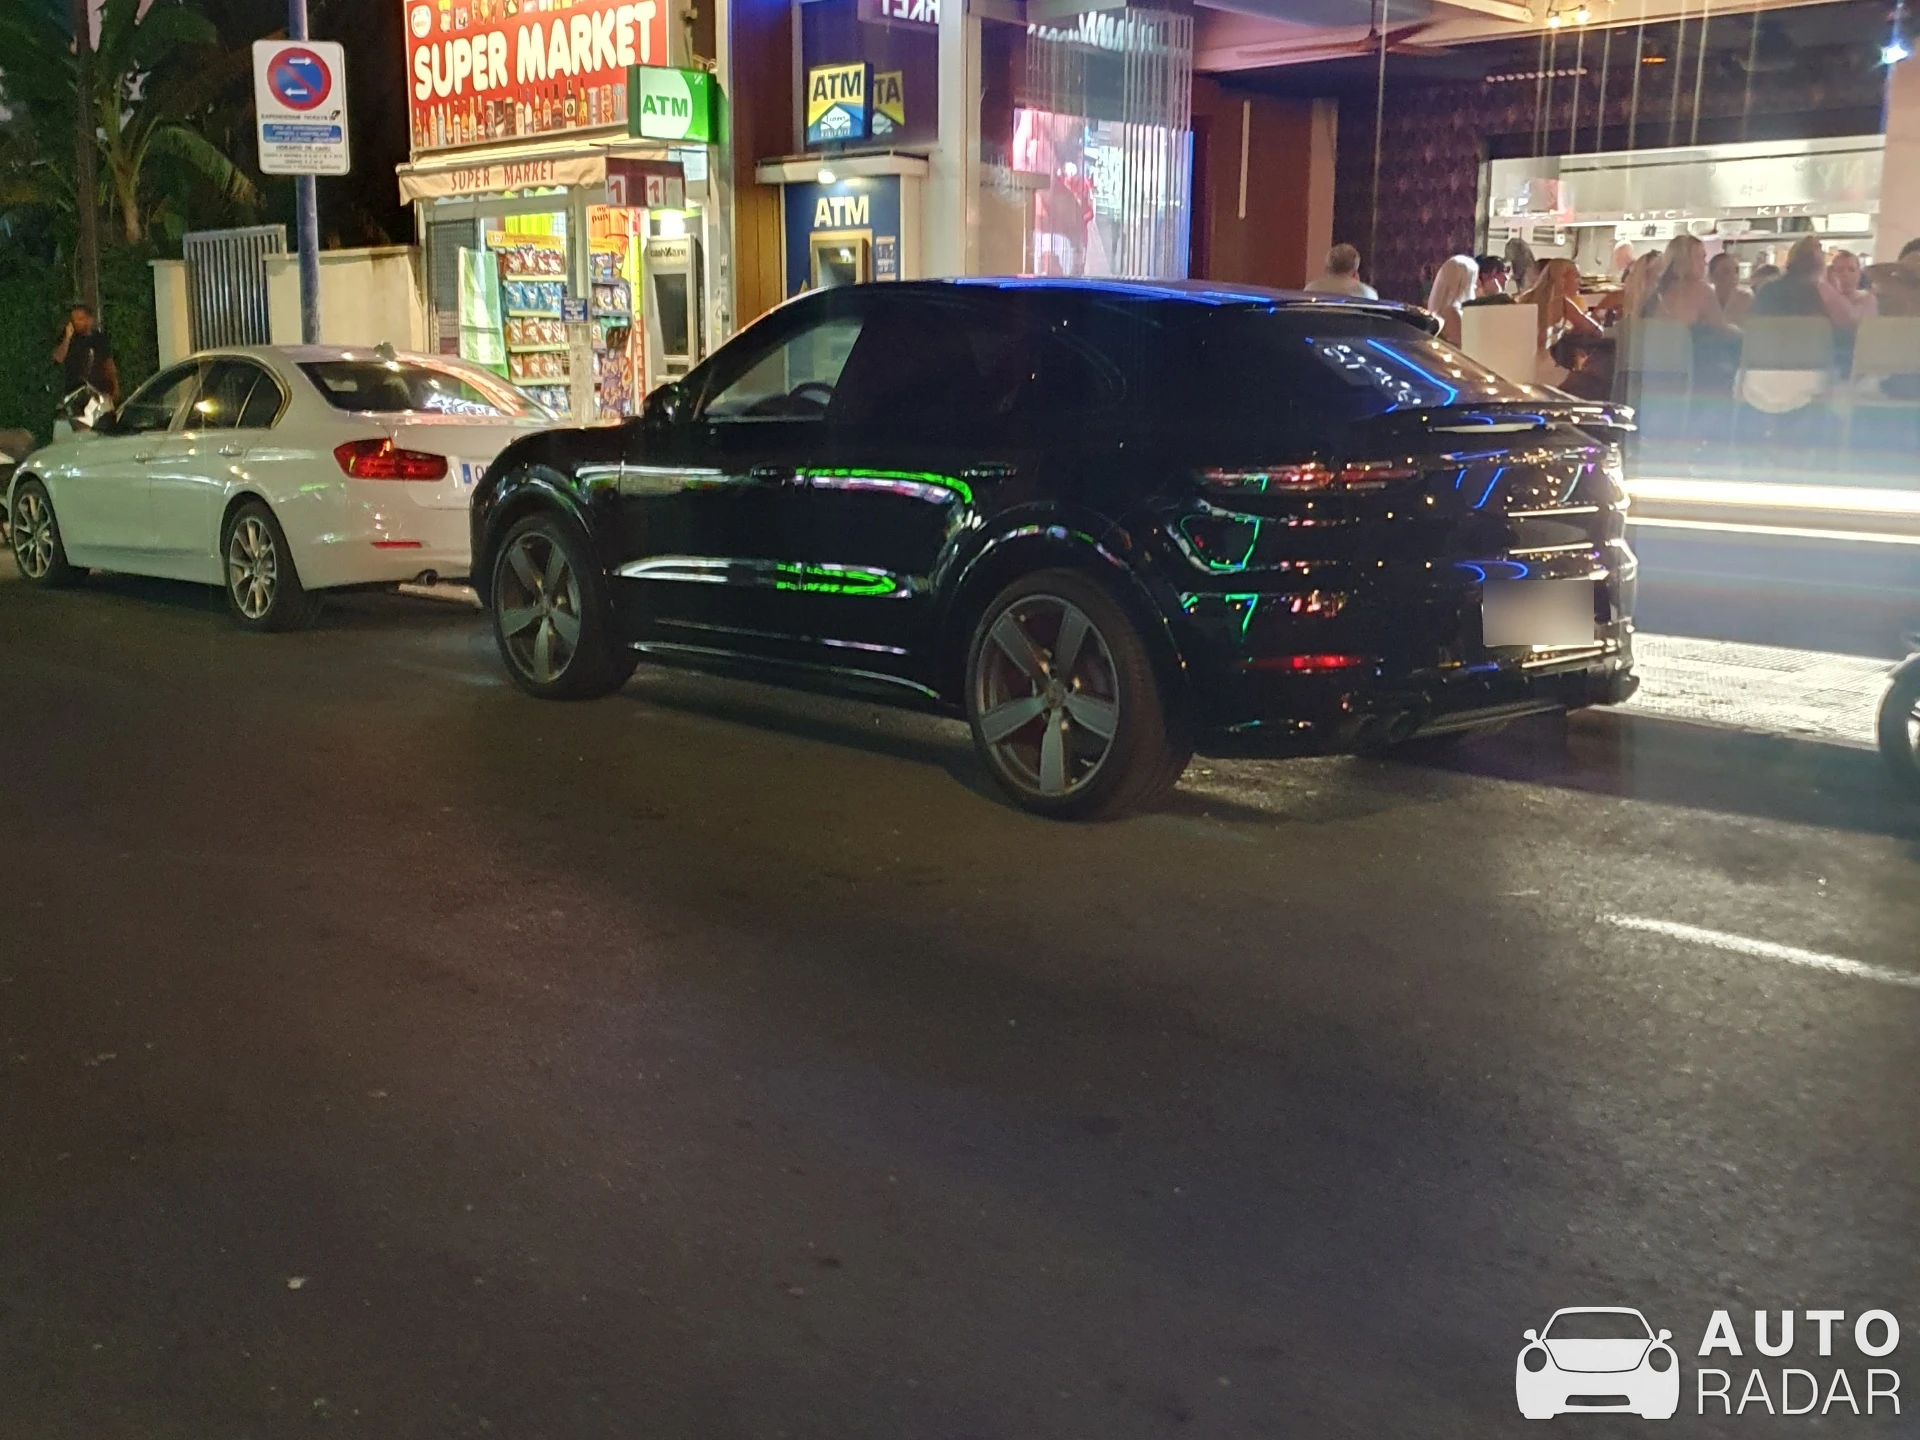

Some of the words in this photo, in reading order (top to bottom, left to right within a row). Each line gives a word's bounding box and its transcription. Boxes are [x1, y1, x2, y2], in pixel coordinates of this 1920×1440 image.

[414, 30, 508, 101] SUPER
[516, 1, 656, 85] MARKET
[812, 69, 862, 102] ATM
[643, 93, 688, 118] ATM
[451, 167, 490, 191] SUPER
[503, 160, 556, 187] MARKET
[813, 195, 869, 228] ATM
